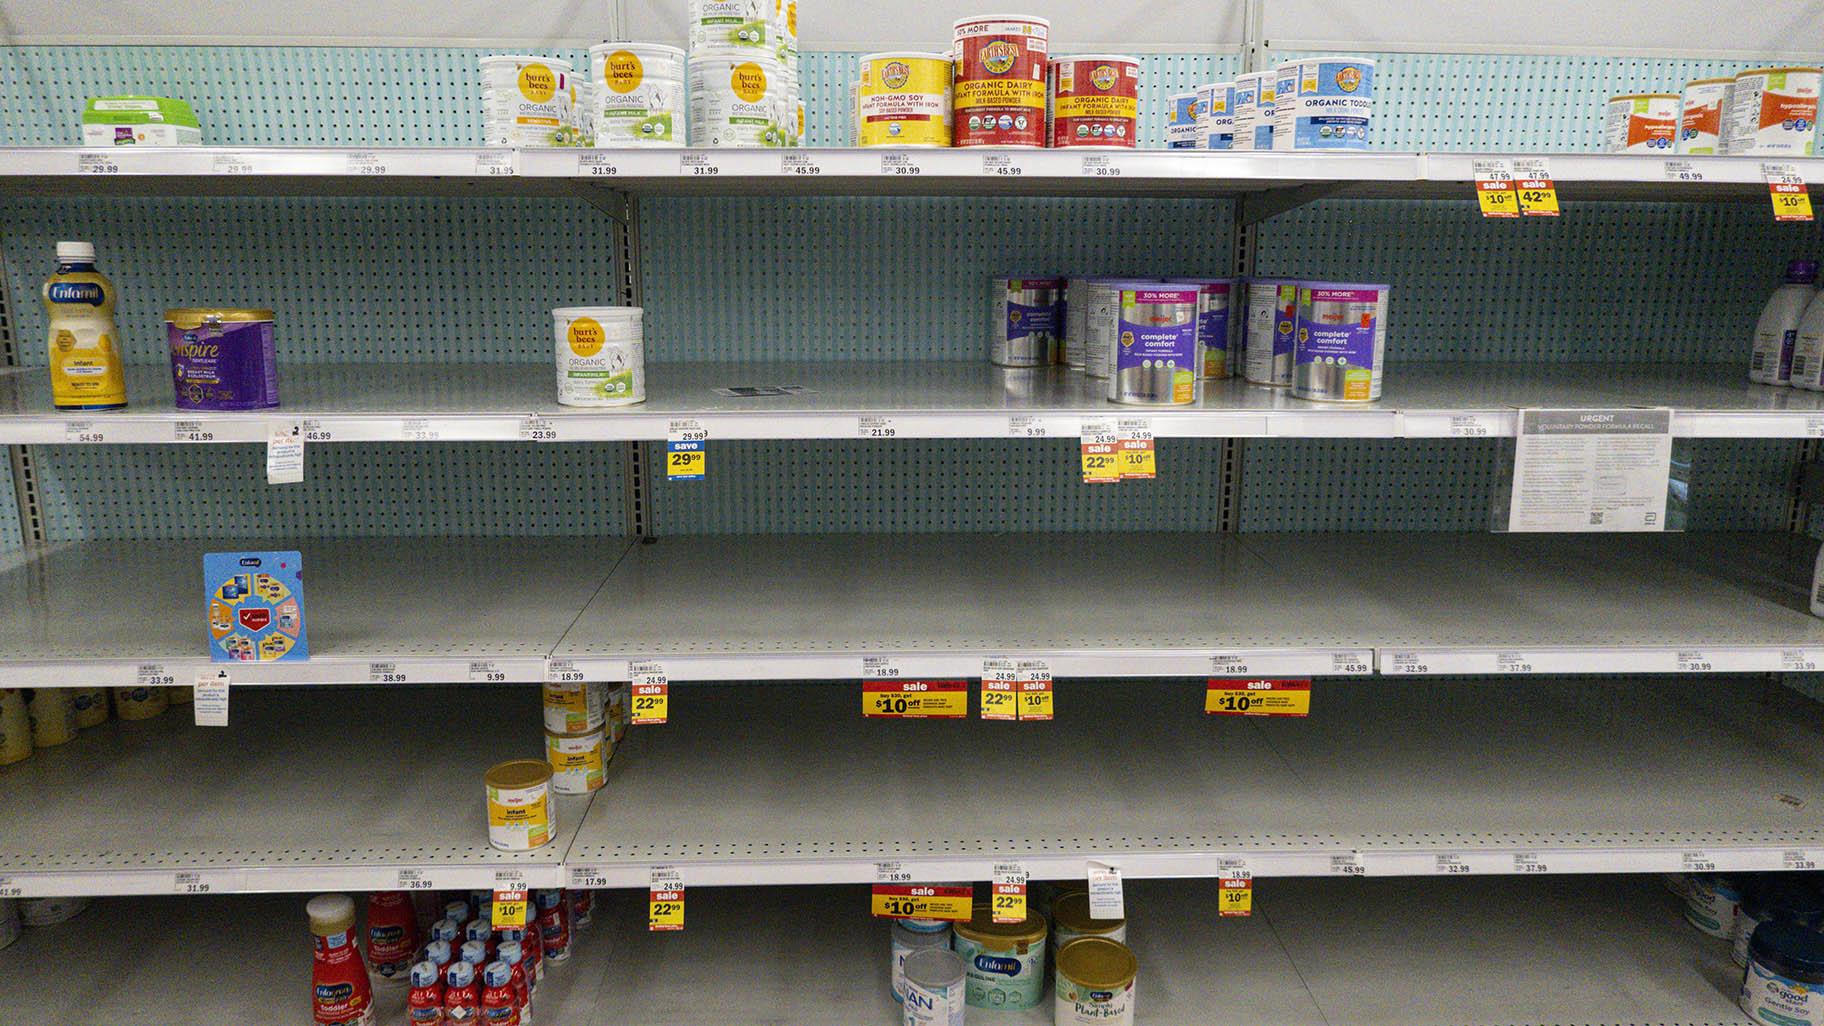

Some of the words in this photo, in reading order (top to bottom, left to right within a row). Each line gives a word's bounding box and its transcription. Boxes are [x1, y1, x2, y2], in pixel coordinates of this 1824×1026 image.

[702, 4, 740, 12] ORGANIC
[968, 25, 989, 33] MORE
[610, 62, 635, 72] burt's
[526, 72, 550, 82] burt's
[613, 70, 633, 79] bees
[739, 72, 762, 81] burt's
[528, 81, 548, 90] bees
[742, 80, 760, 88] bees
[964, 81, 1004, 90] ORGANIC
[1007, 82, 1032, 90] DAIRY
[606, 96, 644, 104] ORGANIC
[1306, 99, 1347, 108] ORGANIC
[520, 104, 557, 113] ORGANIC
[732, 104, 767, 113] ORGANIC
[93, 165, 118, 174] 29.99
[361, 166, 386, 174] 29.99
[895, 167, 920, 175] 30.99
[996, 167, 1022, 175] 45.99
[1490, 172, 1510, 180] 47.99
[1679, 172, 1703, 180] 49.99
[1482, 182, 1507, 190] sale
[1522, 180, 1546, 188] sale
[1775, 184, 1800, 192] sale
[1486, 195, 1504, 204] $10
[1780, 197, 1798, 206] $10
[52, 288, 100, 300] Enfamil
[574, 328, 598, 336] burt's
[1314, 331, 1350, 339] complete
[576, 335, 596, 343] bees
[1140, 334, 1177, 342] complete
[1580, 414, 1614, 422] URGENT
[1537, 423, 1574, 431] VOLUNTARY
[1574, 423, 1600, 431] POWDER
[1632, 422, 1654, 430] RECALL
[307, 432, 332, 440] 46.99
[532, 431, 556, 439] 23.99
[872, 428, 896, 436] 21.99
[1027, 428, 1046, 436] 9.99
[80, 434, 104, 442] 54.99
[189, 433, 213, 441] 41.99
[683, 433, 704, 441] 29.99
[674, 442, 698, 450] save
[1088, 445, 1111, 453] sale
[1124, 441, 1147, 449] sale
[1126, 454, 1142, 464] $10
[150, 676, 174, 684] 33.99
[646, 676, 666, 684] 24.99
[903, 682, 928, 690] sale
[1247, 680, 1272, 690] sale
[638, 686, 661, 694] sale
[1024, 696, 1041, 706] $10
[1218, 696, 1250, 710] $10
[876, 699, 907, 713] $10
[510, 882, 527, 890] 9.99
[585, 878, 606, 886] 17.99
[664, 882, 684, 890] 24.99
[1224, 880, 1246, 888] sale
[911, 888, 935, 896] sale
[998, 884, 1020, 893] sale
[499, 892, 522, 900] sale
[656, 892, 678, 900] sale
[1225, 893, 1240, 902] $10
[499, 905, 516, 916] $10
[884, 902, 914, 914] $10
[978, 958, 1016, 971] Enfamil
[1780, 990, 1808, 1002] good
[1075, 1002, 1125, 1017] Plant-Based
[1794, 1006, 1810, 1015] Soy
